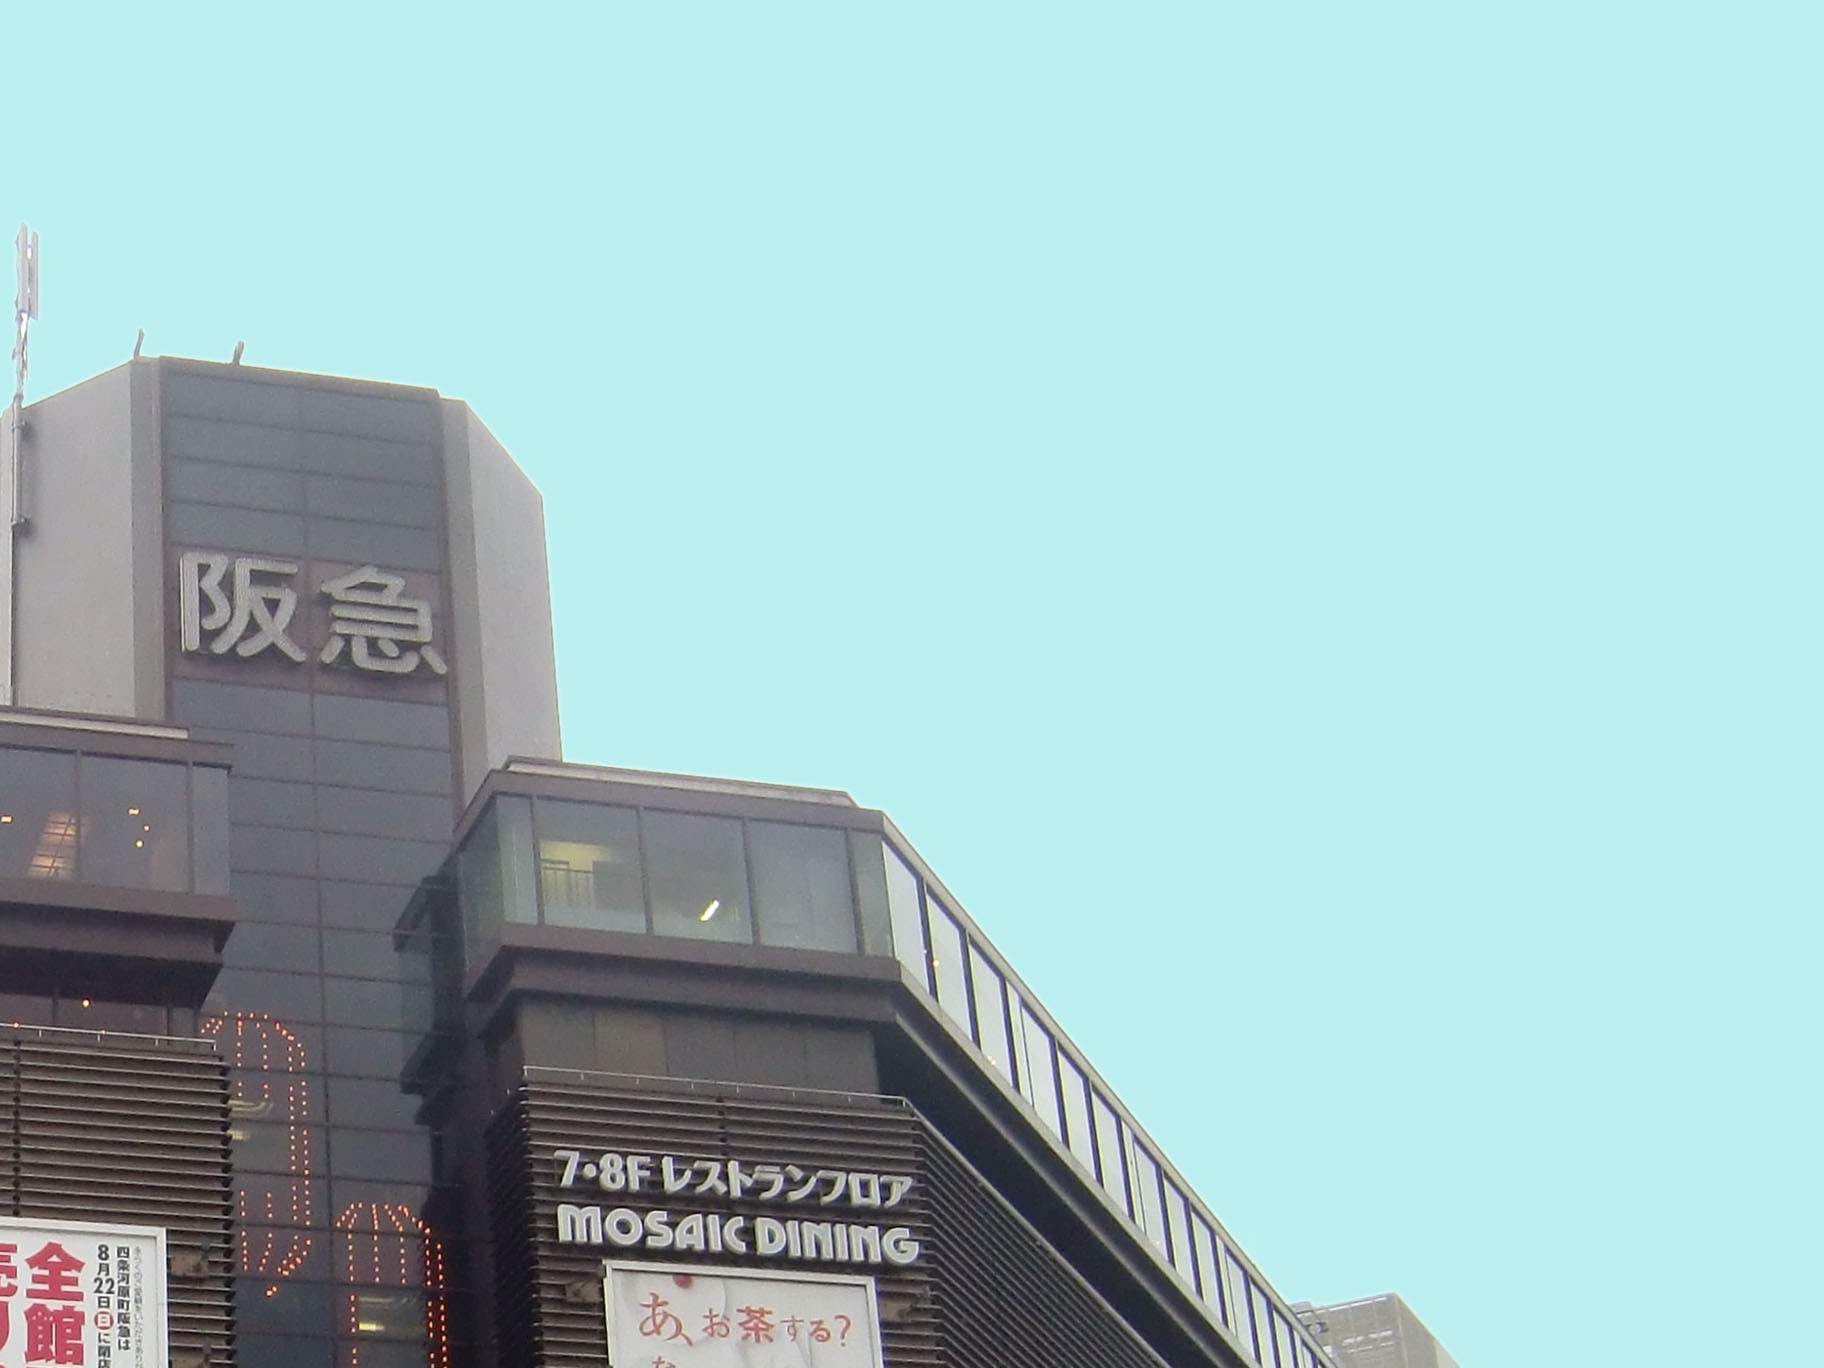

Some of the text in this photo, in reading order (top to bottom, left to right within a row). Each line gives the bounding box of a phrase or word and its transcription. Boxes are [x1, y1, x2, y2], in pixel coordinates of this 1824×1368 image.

[180, 552, 448, 677] 阪急
[662, 1156, 914, 1208] レストランフロア
[557, 1203, 920, 1266] MOSAIC DINING
